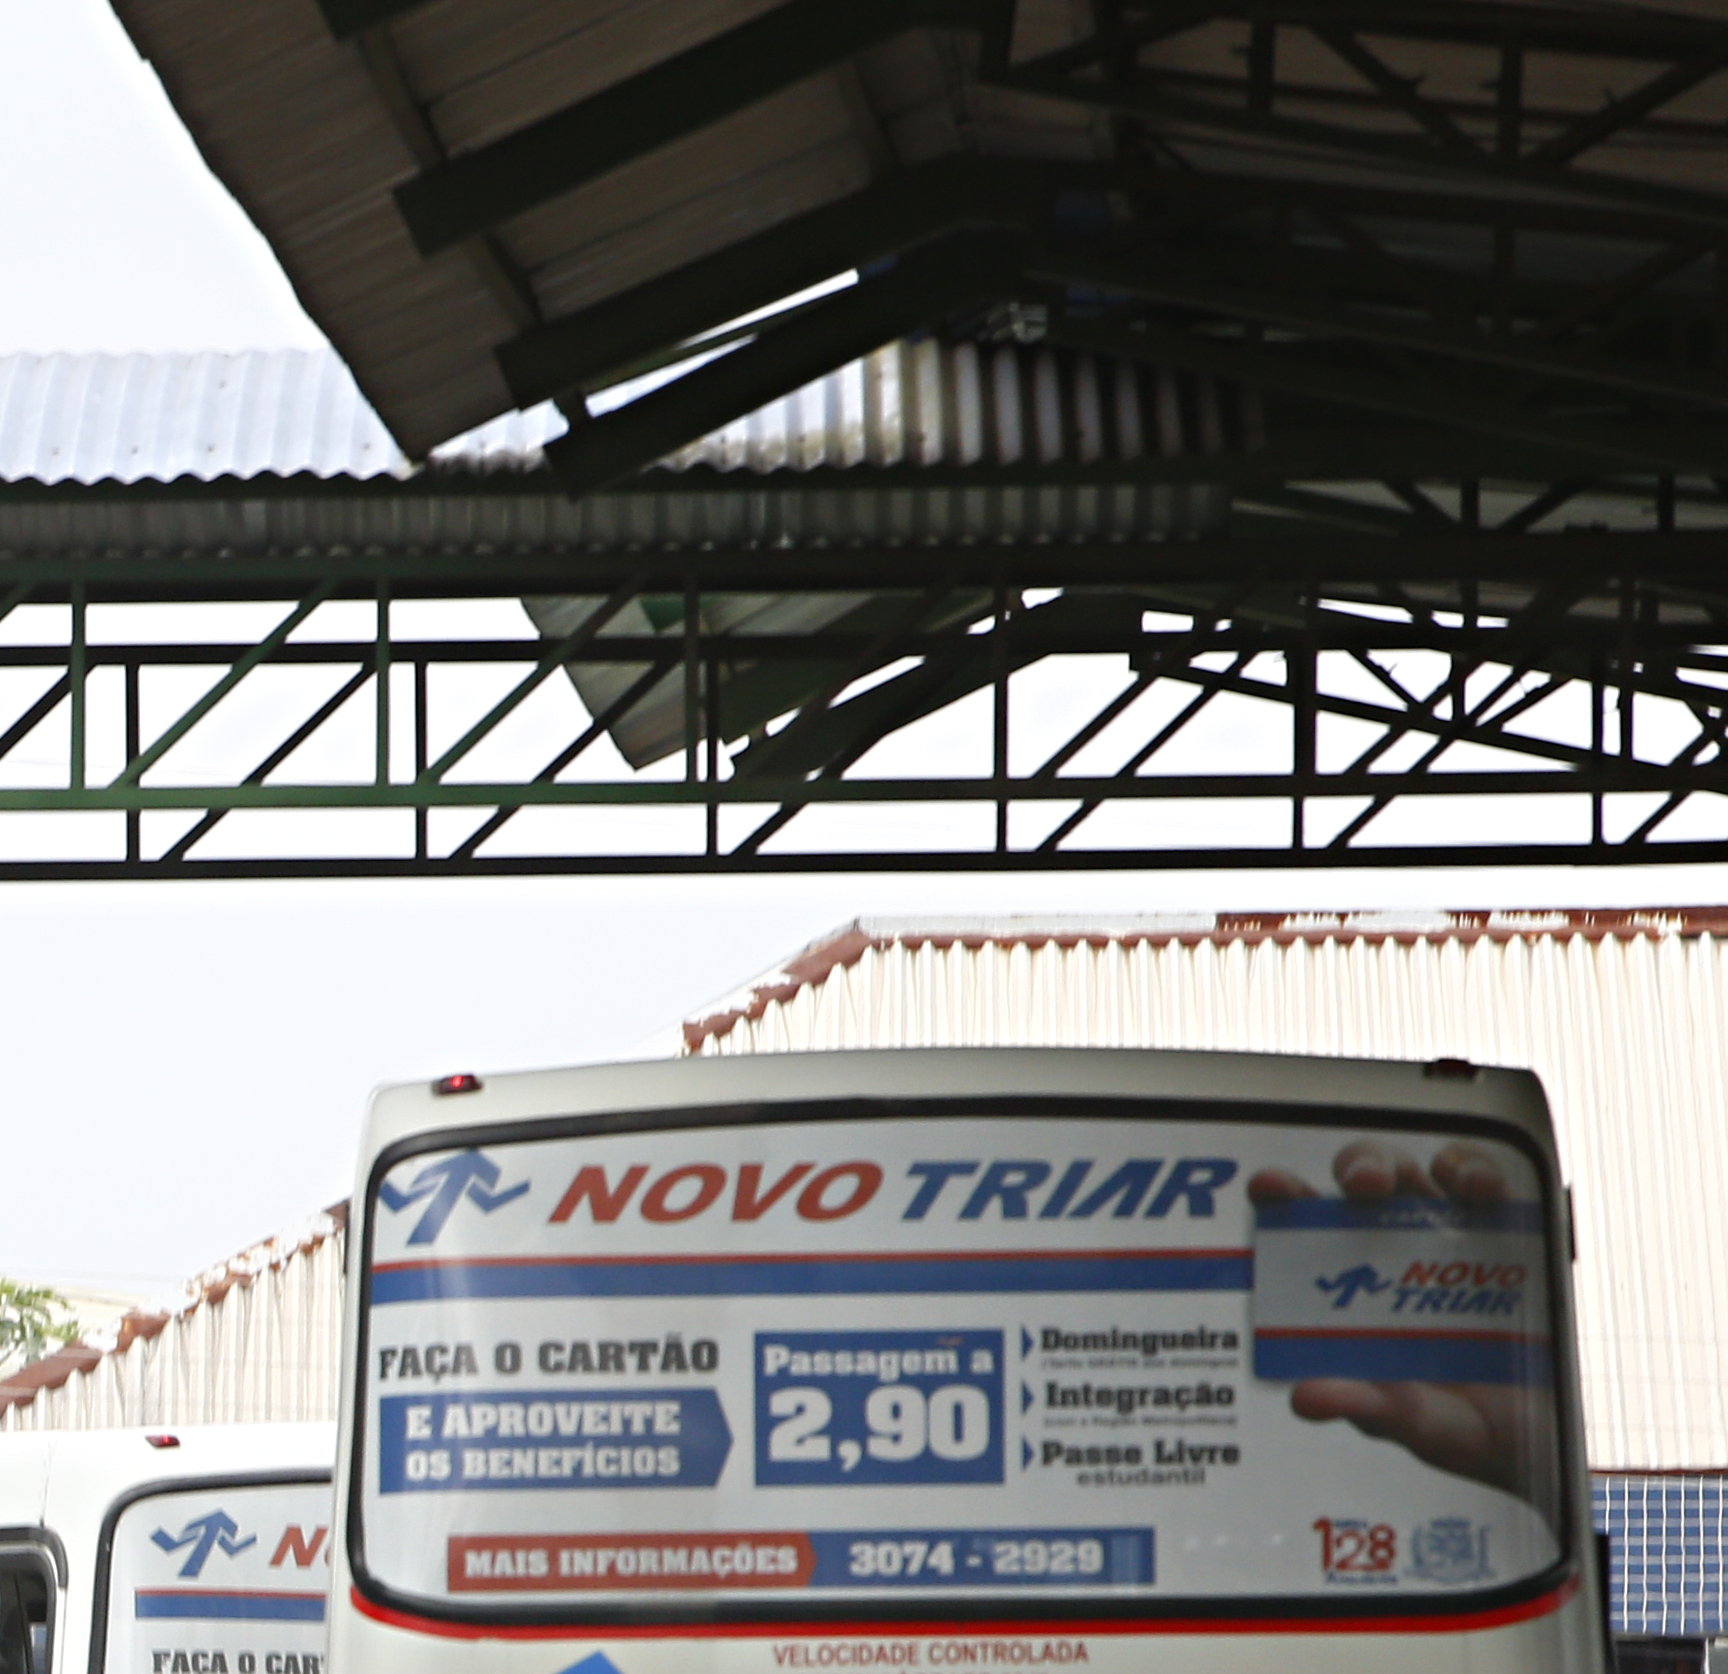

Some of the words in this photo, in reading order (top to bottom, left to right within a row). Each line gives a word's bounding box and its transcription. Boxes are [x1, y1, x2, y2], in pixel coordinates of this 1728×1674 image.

[548, 1162, 884, 1224] NOVO
[901, 1157, 1238, 1222] TRIAR
[1400, 1260, 1527, 1288] NOVO
[380, 1345, 478, 1386] FAÇA
[495, 1341, 523, 1376] O
[538, 1331, 720, 1375] CARTÃO
[1042, 1327, 1239, 1356] Domingueira
[764, 1343, 959, 1382] Passagem
[971, 1350, 994, 1375] a
[1046, 1382, 1236, 1417] Integração
[406, 1406, 432, 1440] E
[444, 1402, 681, 1438] APROVEITE
[770, 1384, 990, 1472] 2,90
[406, 1450, 450, 1480] OS
[462, 1443, 681, 1477] BENEFÍCIOS
[1042, 1440, 1142, 1466] Passe
[1155, 1437, 1241, 1466] Livre
[269, 1523, 331, 1569] N
[464, 1546, 551, 1578] MAIS
[560, 1542, 799, 1577] INFORMAÇÕES
[850, 1542, 955, 1576] 3074
[994, 1540, 1104, 1574] 2929
[1313, 1517, 1396, 1572] 128
[773, 1642, 920, 1668] VELOCIDADE
[929, 1640, 1090, 1666] CONTROLADA
